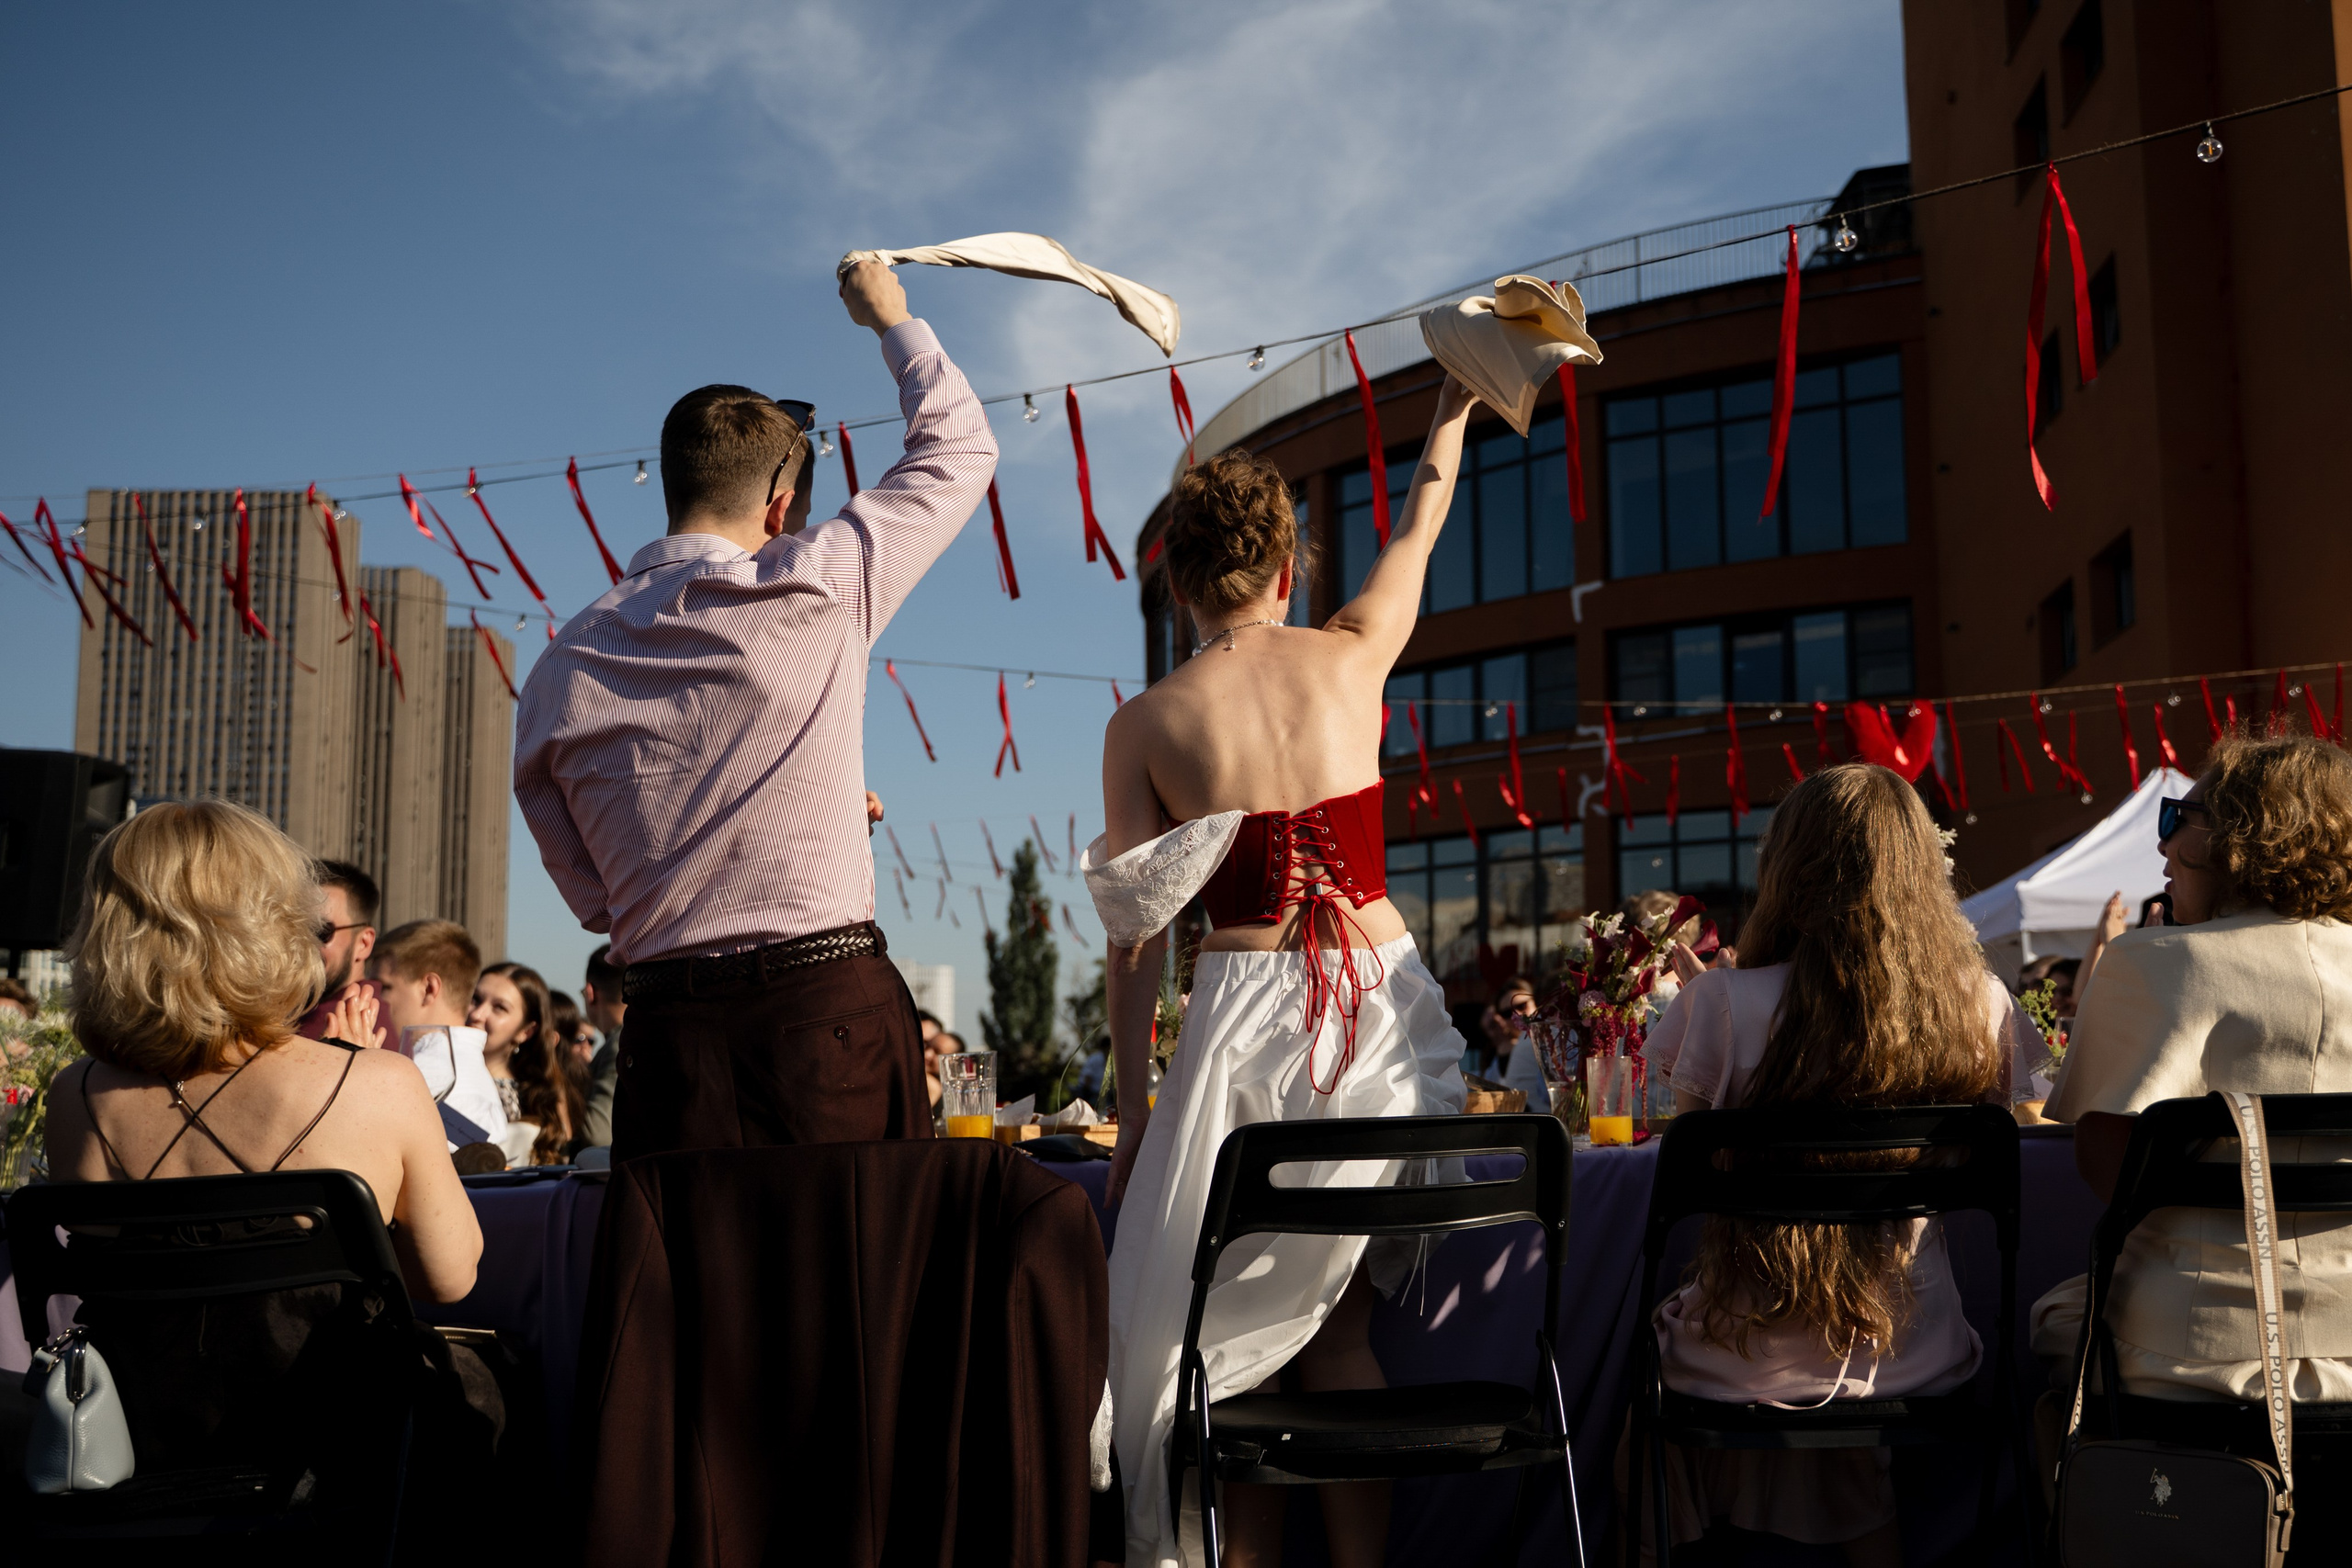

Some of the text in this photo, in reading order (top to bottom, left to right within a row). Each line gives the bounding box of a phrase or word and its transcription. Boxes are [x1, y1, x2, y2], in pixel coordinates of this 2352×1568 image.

[2240, 1105, 2271, 1266] U.S. POLO ASSN.
[2265, 1312, 2279, 1348] U.S.
[2269, 1356, 2284, 1412] POLO
